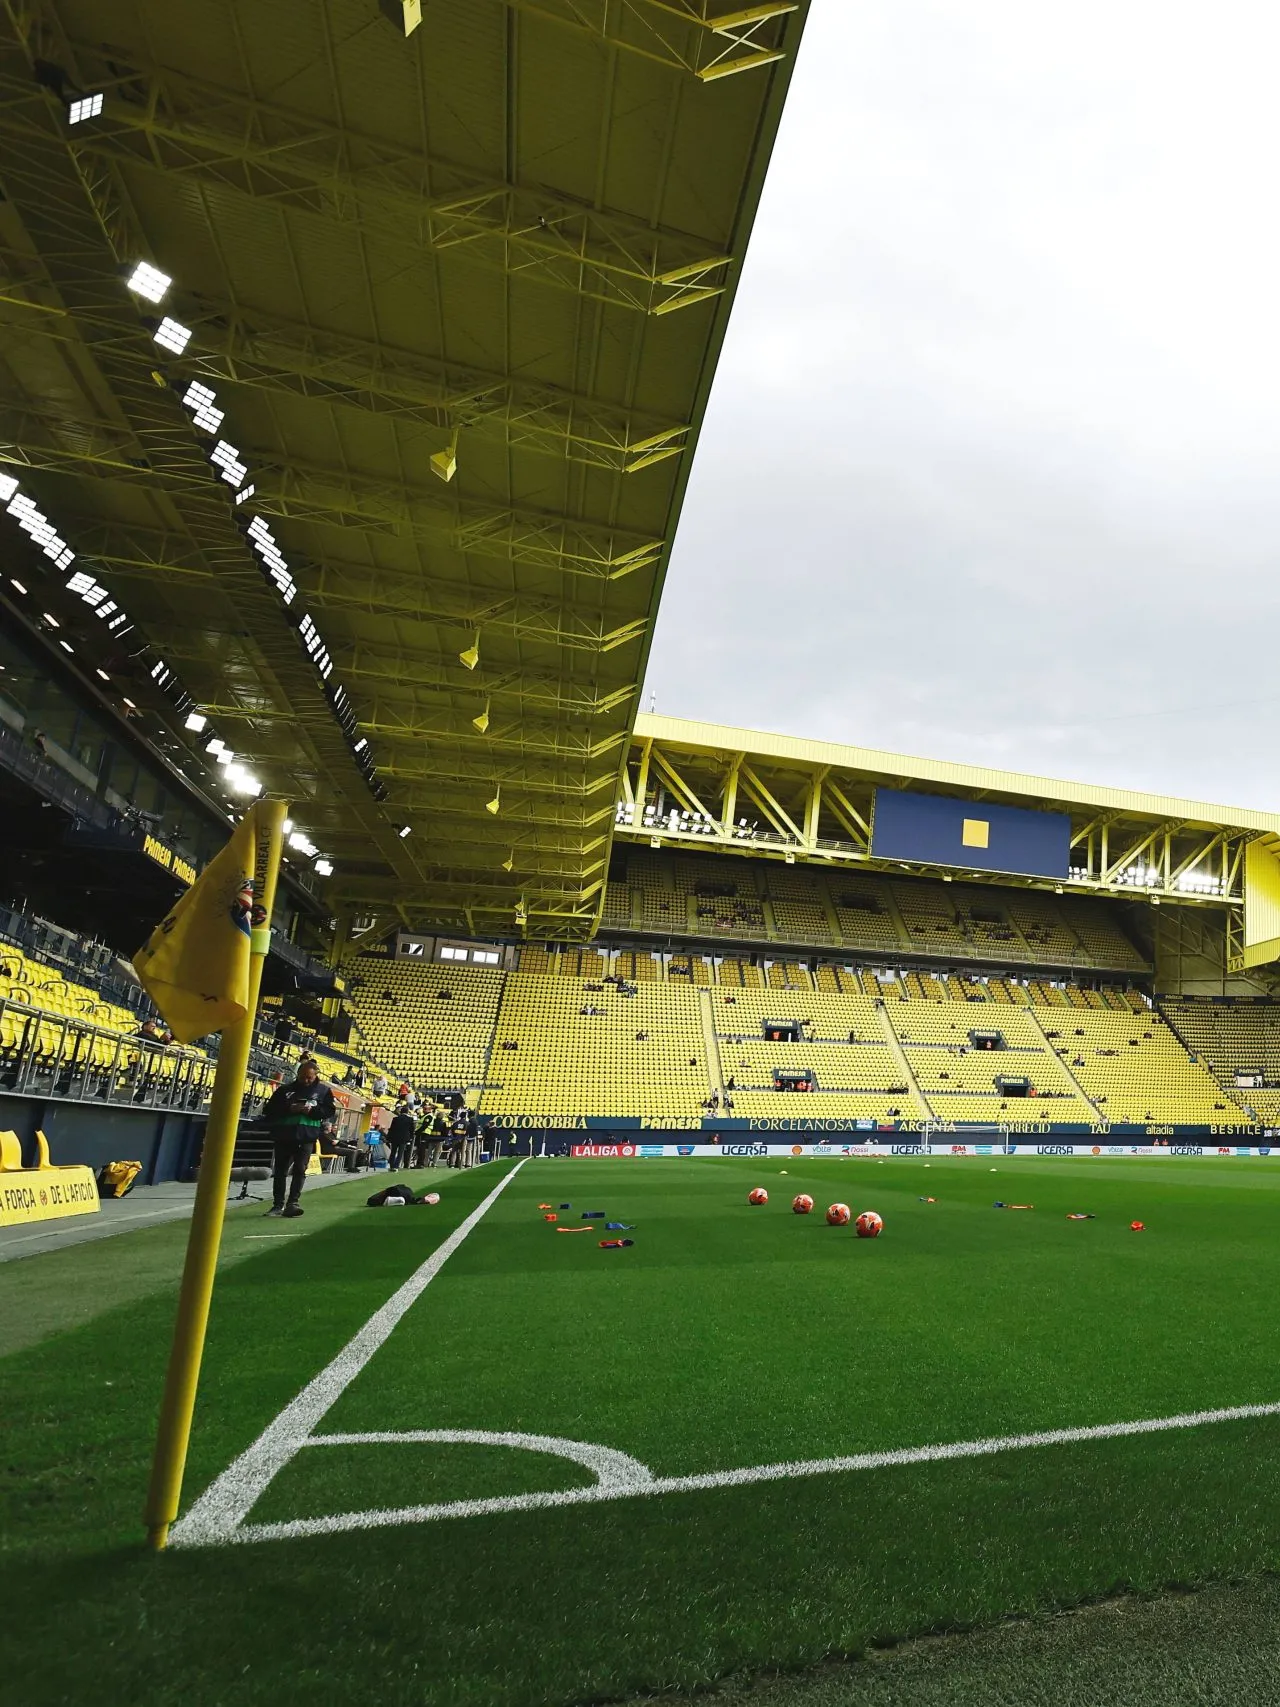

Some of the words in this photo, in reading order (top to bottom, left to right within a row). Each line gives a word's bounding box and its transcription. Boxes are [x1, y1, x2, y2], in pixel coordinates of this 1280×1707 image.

[253, 841, 270, 901] VILLARREAL
[494, 1115, 588, 1129] COLOROBBIA
[641, 1117, 702, 1130] PAMESA
[750, 1119, 853, 1131] PORCELANOSA
[899, 1121, 957, 1132] ARGENTA
[997, 1122, 1051, 1133] TORRECID
[1089, 1123, 1111, 1134] TAU
[1145, 1125, 1174, 1135] altadia
[1210, 1125, 1261, 1135] BESTILE
[575, 1145, 618, 1156] LALIGA
[722, 1145, 768, 1155] UCERSA
[891, 1145, 932, 1155] UCERSA
[1037, 1145, 1074, 1155] UCERSA
[1170, 1146, 1203, 1156] UCERSA
[5, 1187, 36, 1214] FORÇA
[50, 1185, 63, 1205] DE
[63, 1177, 94, 1203] L'AFICIÓ
